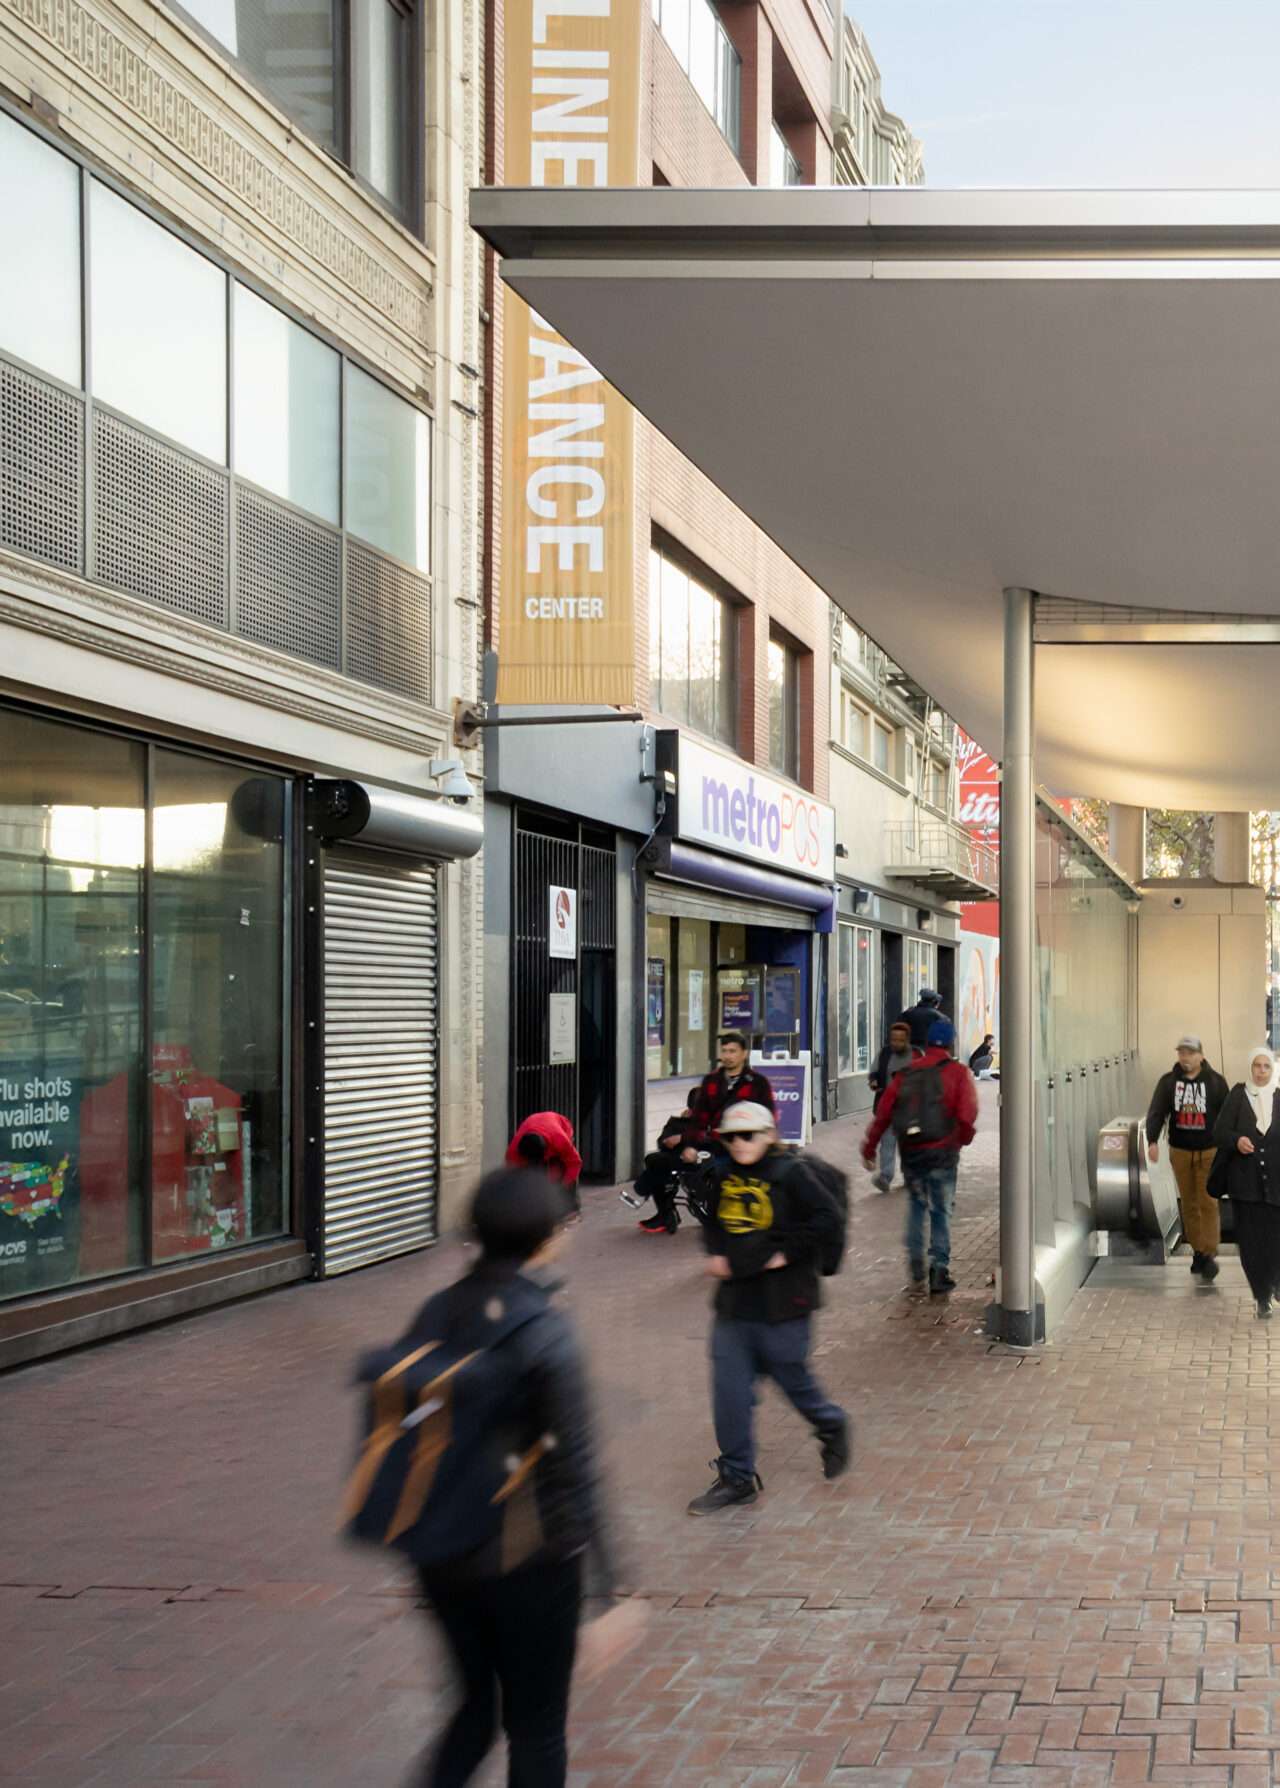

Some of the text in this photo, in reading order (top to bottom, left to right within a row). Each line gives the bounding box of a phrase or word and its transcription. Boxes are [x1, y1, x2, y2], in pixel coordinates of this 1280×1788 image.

[526, 308, 605, 573] ANCE
[525, 597, 604, 619] CENTER
[702, 775, 819, 867] metroPCS
[0, 1076, 73, 1101] lu shots
[11, 1129, 53, 1149] now.
